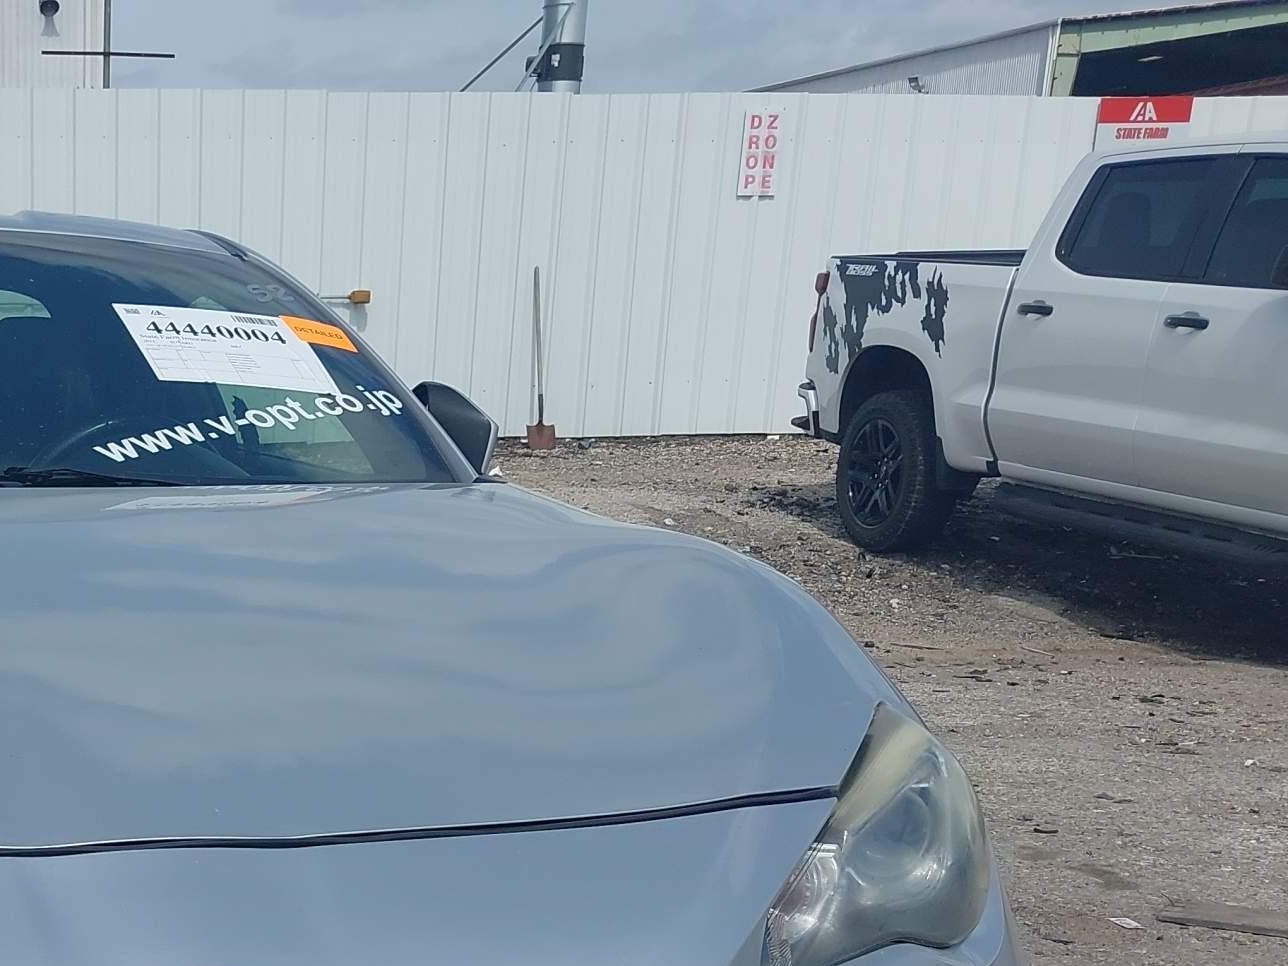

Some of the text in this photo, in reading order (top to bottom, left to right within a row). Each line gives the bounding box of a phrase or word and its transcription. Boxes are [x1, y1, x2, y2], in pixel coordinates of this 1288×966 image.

[1115, 127, 1169, 140] STATE FARM
[145, 320, 287, 345] 44440004
[93, 385, 403, 462] www.v-opt.co.jp
